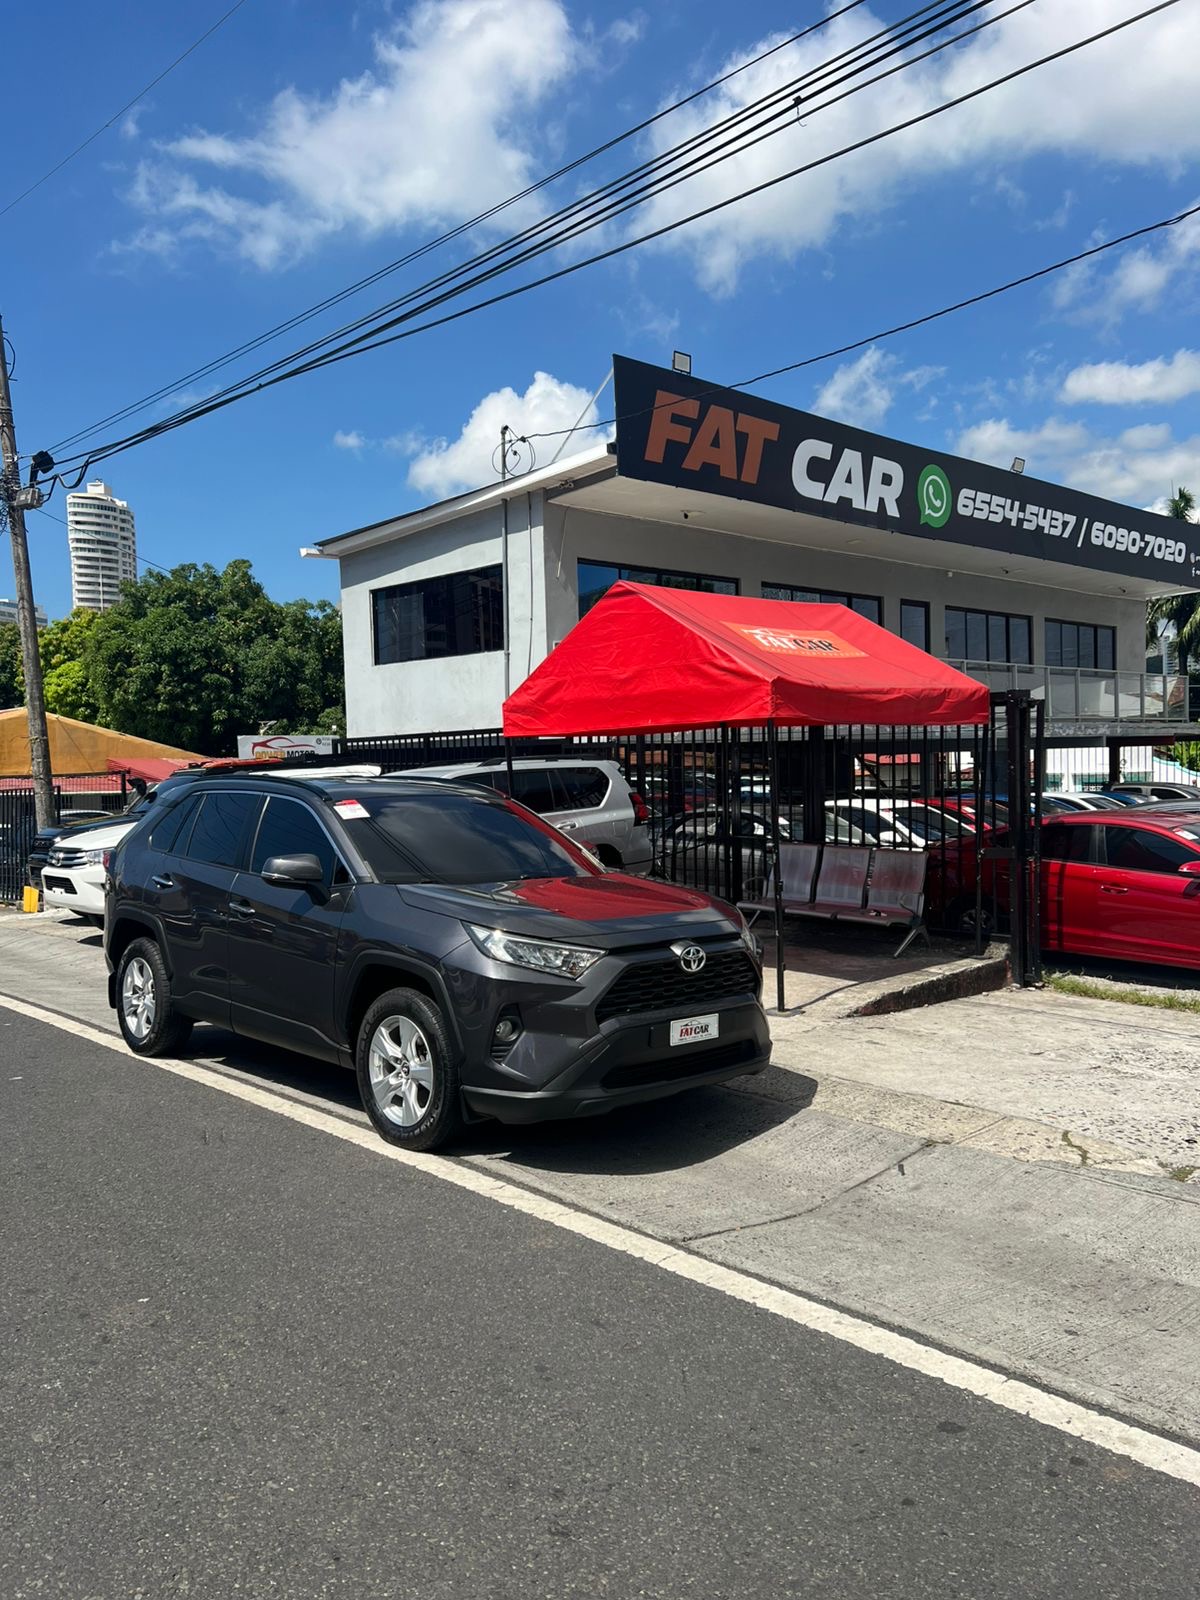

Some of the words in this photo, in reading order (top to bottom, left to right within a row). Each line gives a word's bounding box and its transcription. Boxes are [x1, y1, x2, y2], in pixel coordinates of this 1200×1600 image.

[644, 389, 781, 485] FAT
[792, 438, 904, 518] CAR
[957, 487, 1077, 538] 6554-5437
[1090, 521, 1186, 564] 6090-7020
